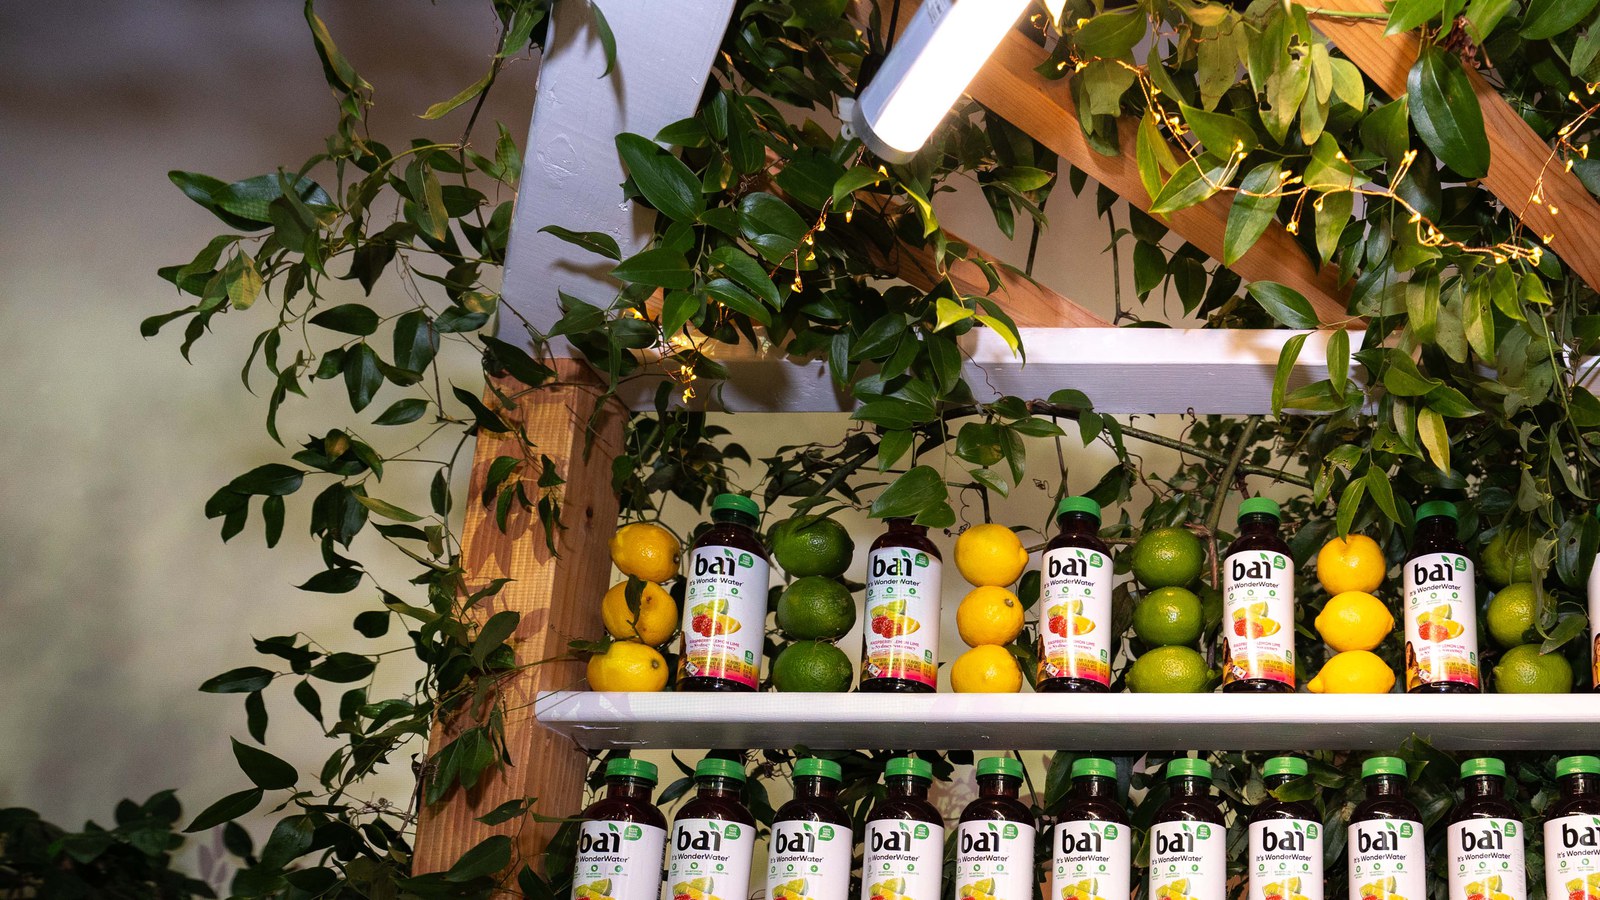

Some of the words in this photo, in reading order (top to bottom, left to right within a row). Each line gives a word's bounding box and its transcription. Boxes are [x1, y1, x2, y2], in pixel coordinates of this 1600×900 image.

[695, 548, 736, 576] bai
[873, 549, 912, 577] bai
[1048, 550, 1087, 578] bai
[1232, 553, 1271, 581] bai
[1414, 555, 1453, 585] bai
[696, 577, 742, 587] WondeWater
[1050, 578, 1095, 587] WonderWater
[1234, 581, 1279, 589] WonderWater
[1417, 583, 1461, 593] WonderWater
[580, 823, 620, 853] bai
[677, 821, 721, 851] bai
[775, 823, 816, 854] bai
[871, 822, 911, 852] bai
[961, 822, 1000, 853] bai
[1062, 823, 1102, 854] bai
[1156, 823, 1194, 855] bai
[1262, 821, 1304, 852] bai
[1357, 821, 1398, 853] bai
[1461, 820, 1503, 852] bai
[580, 855, 628, 863] WonderWater
[677, 853, 729, 862] WonderWater
[776, 855, 822, 863] WonderWater
[872, 854, 919, 862] WonderWater
[1064, 855, 1109, 863] WonderWater
[1158, 855, 1202, 863] WonderWater
[1265, 853, 1311, 861] WonderWater
[1360, 853, 1406, 862] WonderWater
[1464, 852, 1511, 860] WonderWater
